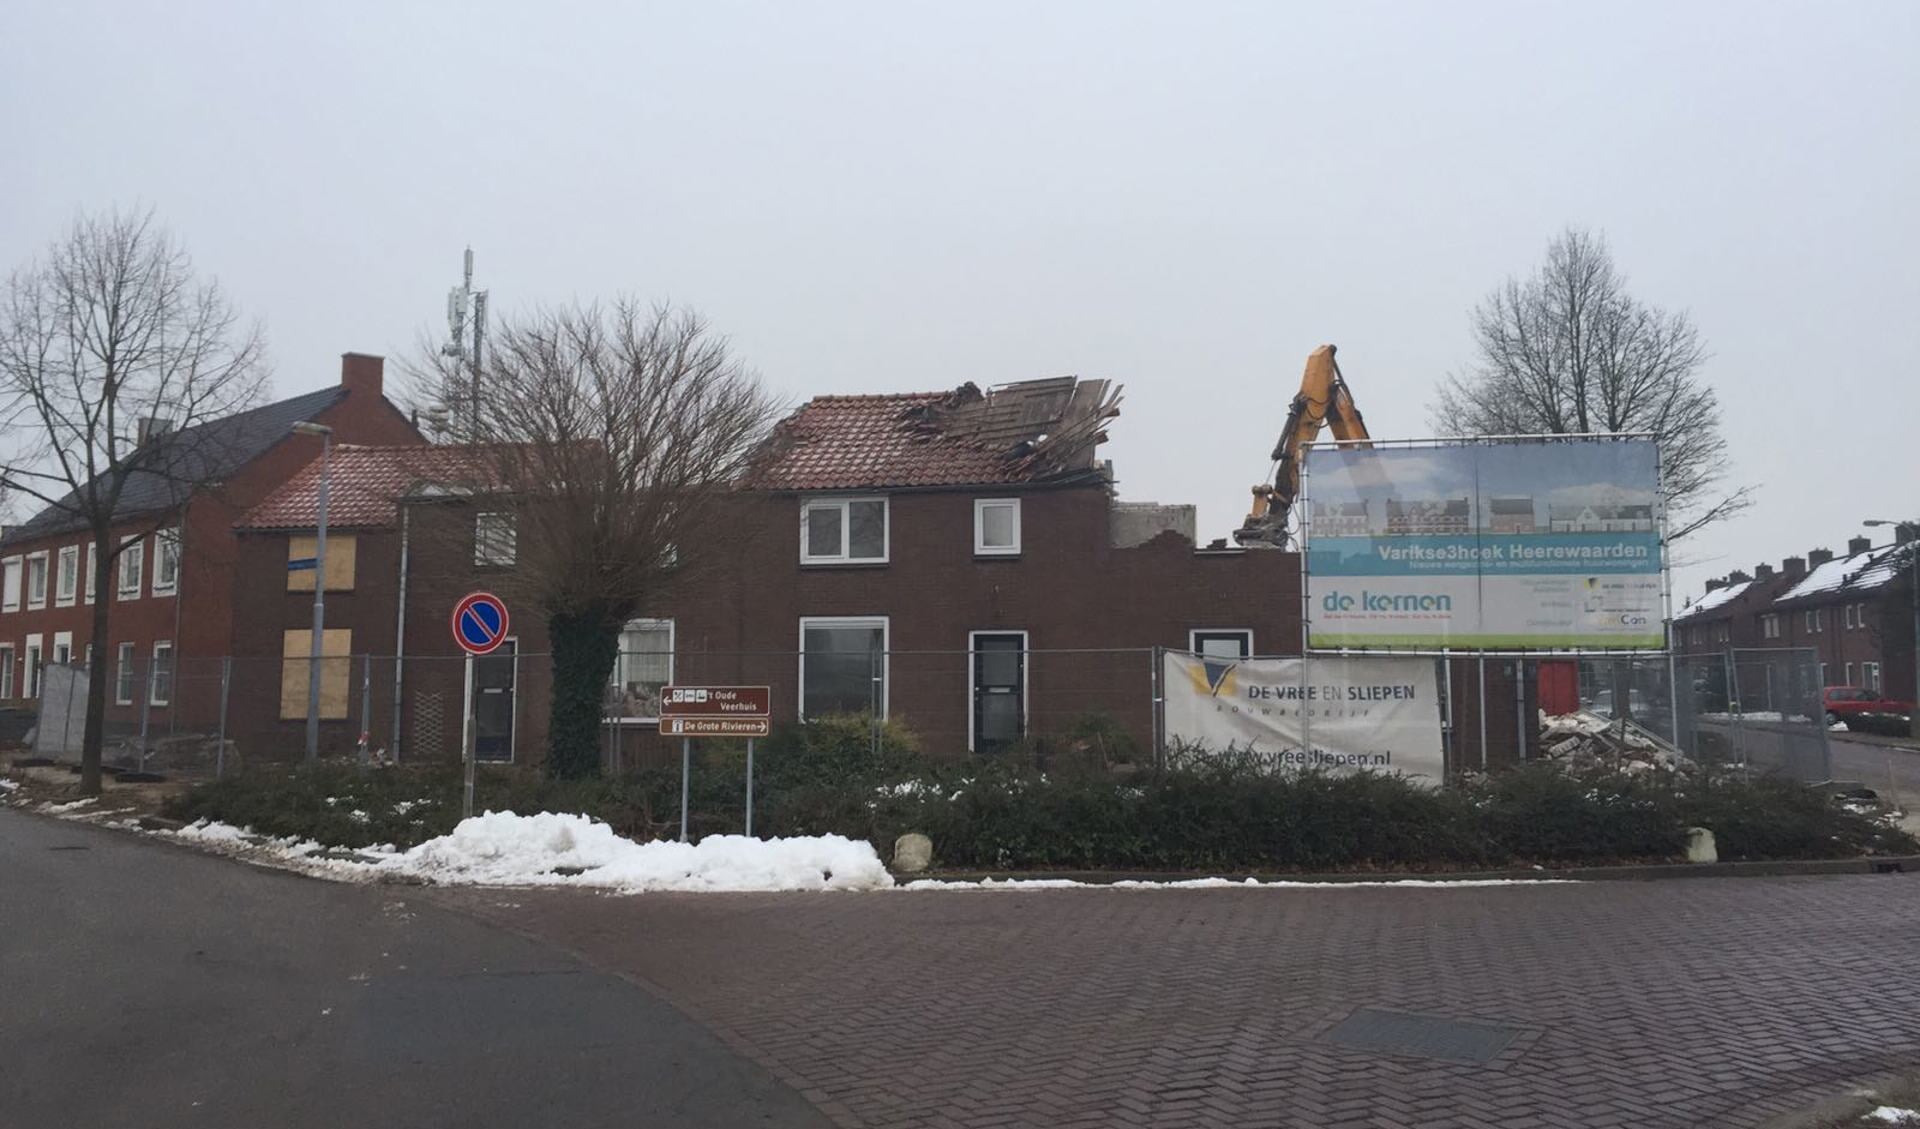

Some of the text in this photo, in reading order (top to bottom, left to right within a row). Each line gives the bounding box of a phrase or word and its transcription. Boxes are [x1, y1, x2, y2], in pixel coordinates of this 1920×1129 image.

[1378, 541, 1648, 561] Varikse3hoek Heerewaarden
[1322, 590, 1451, 612] de kernen
[714, 691, 738, 700] Oude
[1248, 684, 1416, 701] DE VREE EN SLIEPEN
[720, 702, 758, 712] Veerhuis
[684, 721, 757, 730] De Grote Rivieren
[1219, 750, 1391, 769] w.vreesliepen.nl
